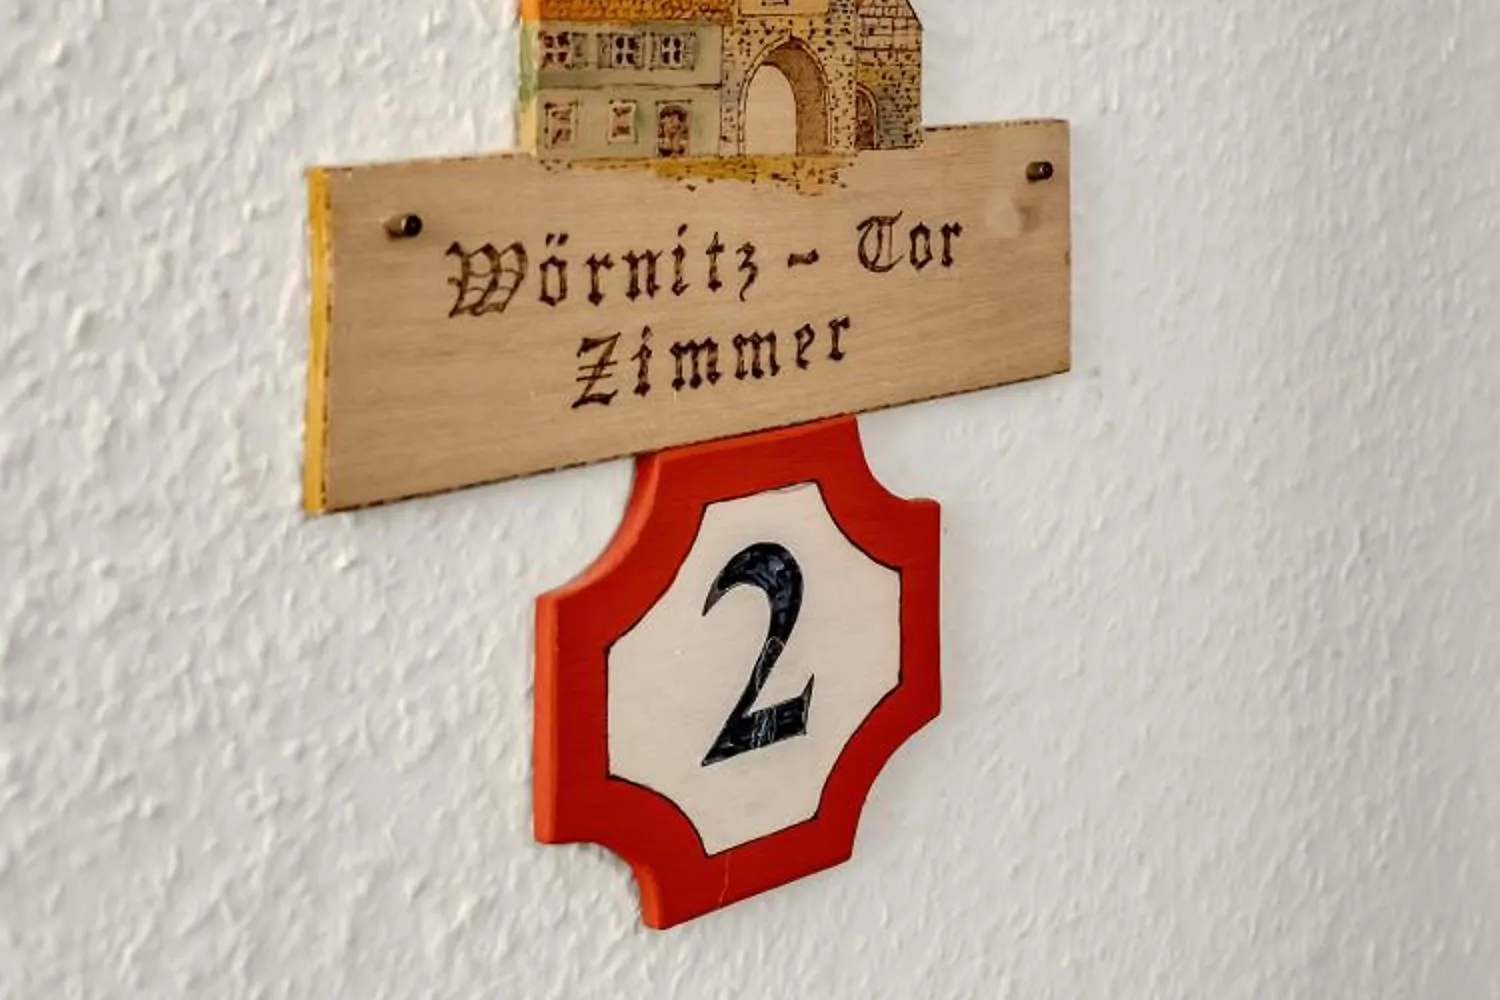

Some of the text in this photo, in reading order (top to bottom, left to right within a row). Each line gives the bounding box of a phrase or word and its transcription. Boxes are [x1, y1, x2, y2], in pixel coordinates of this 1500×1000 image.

[446, 224, 760, 318] Wörnitz
[856, 211, 963, 273] Tor
[571, 314, 851, 409] Zimmer
[701, 542, 815, 767] 2
